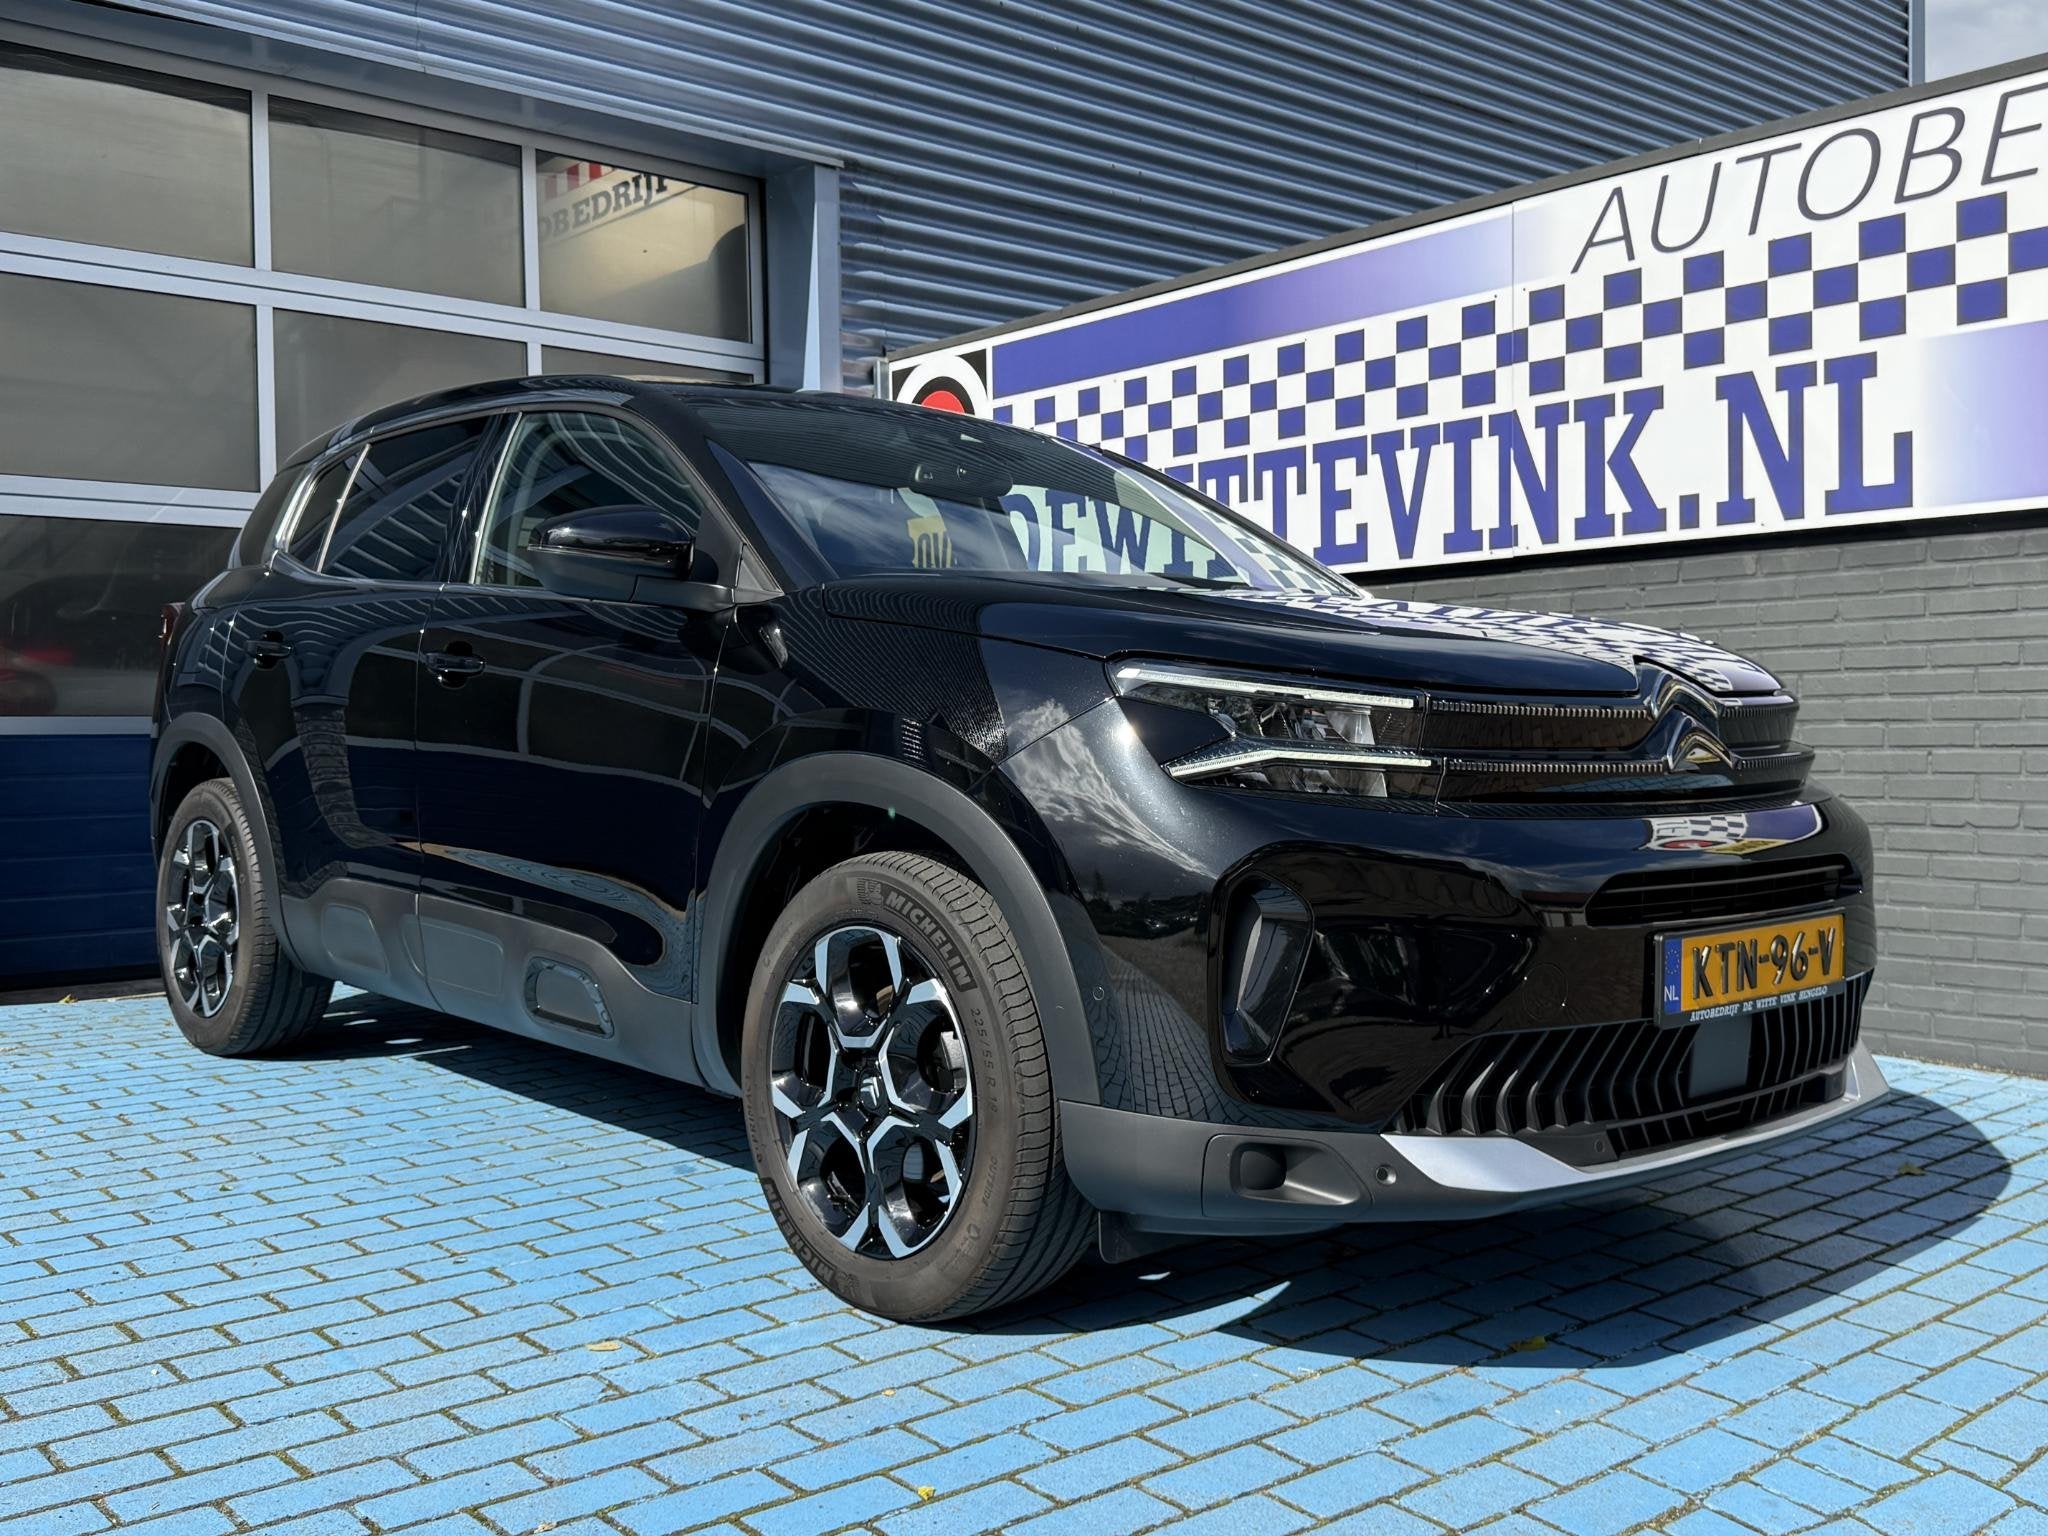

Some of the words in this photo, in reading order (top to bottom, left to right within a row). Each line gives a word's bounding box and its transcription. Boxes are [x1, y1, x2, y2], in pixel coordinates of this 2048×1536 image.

[1571, 82, 2048, 274] AUTOBE
[885, 890, 972, 986] MICHELIN
[1692, 927, 1836, 1000] KTN-96-V
[1664, 986, 1679, 1003] NL
[1689, 1003, 1740, 1022] AUTOBEDRIJF
[1742, 1001, 1754, 1012] DE
[1756, 997, 1778, 1009] WITTE
[1780, 993, 1796, 1004] VINK
[1798, 985, 1829, 1001] HENGELO
